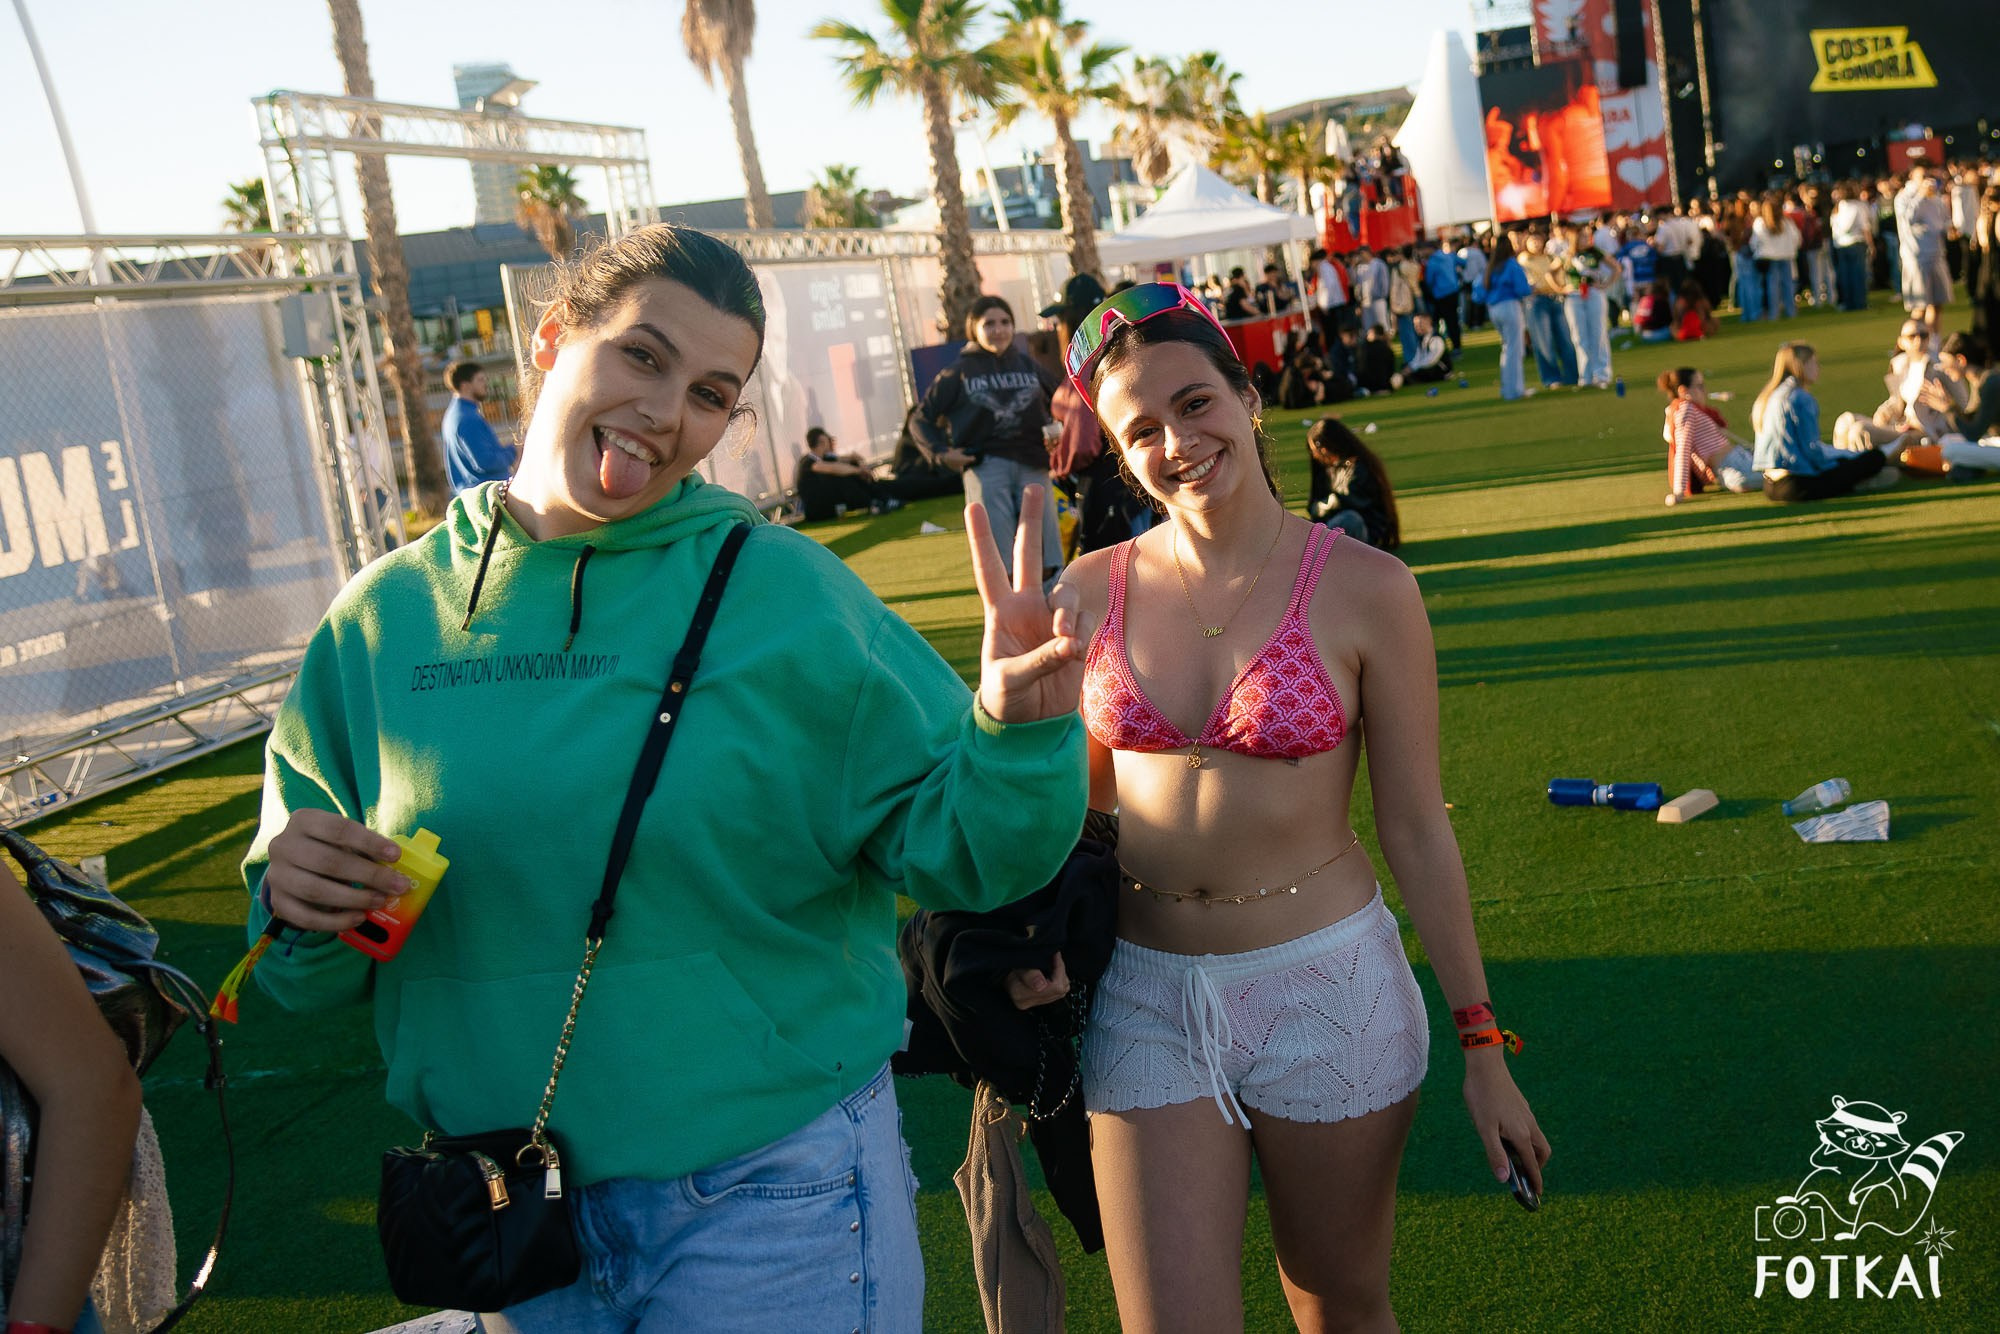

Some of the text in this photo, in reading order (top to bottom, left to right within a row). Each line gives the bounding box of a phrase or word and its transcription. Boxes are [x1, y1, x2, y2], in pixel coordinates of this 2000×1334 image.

[1825, 36, 1894, 64] COSTA
[962, 373, 989, 396] LOS
[411, 652, 620, 692] DESTINATION UNKNOWN MMXVII
